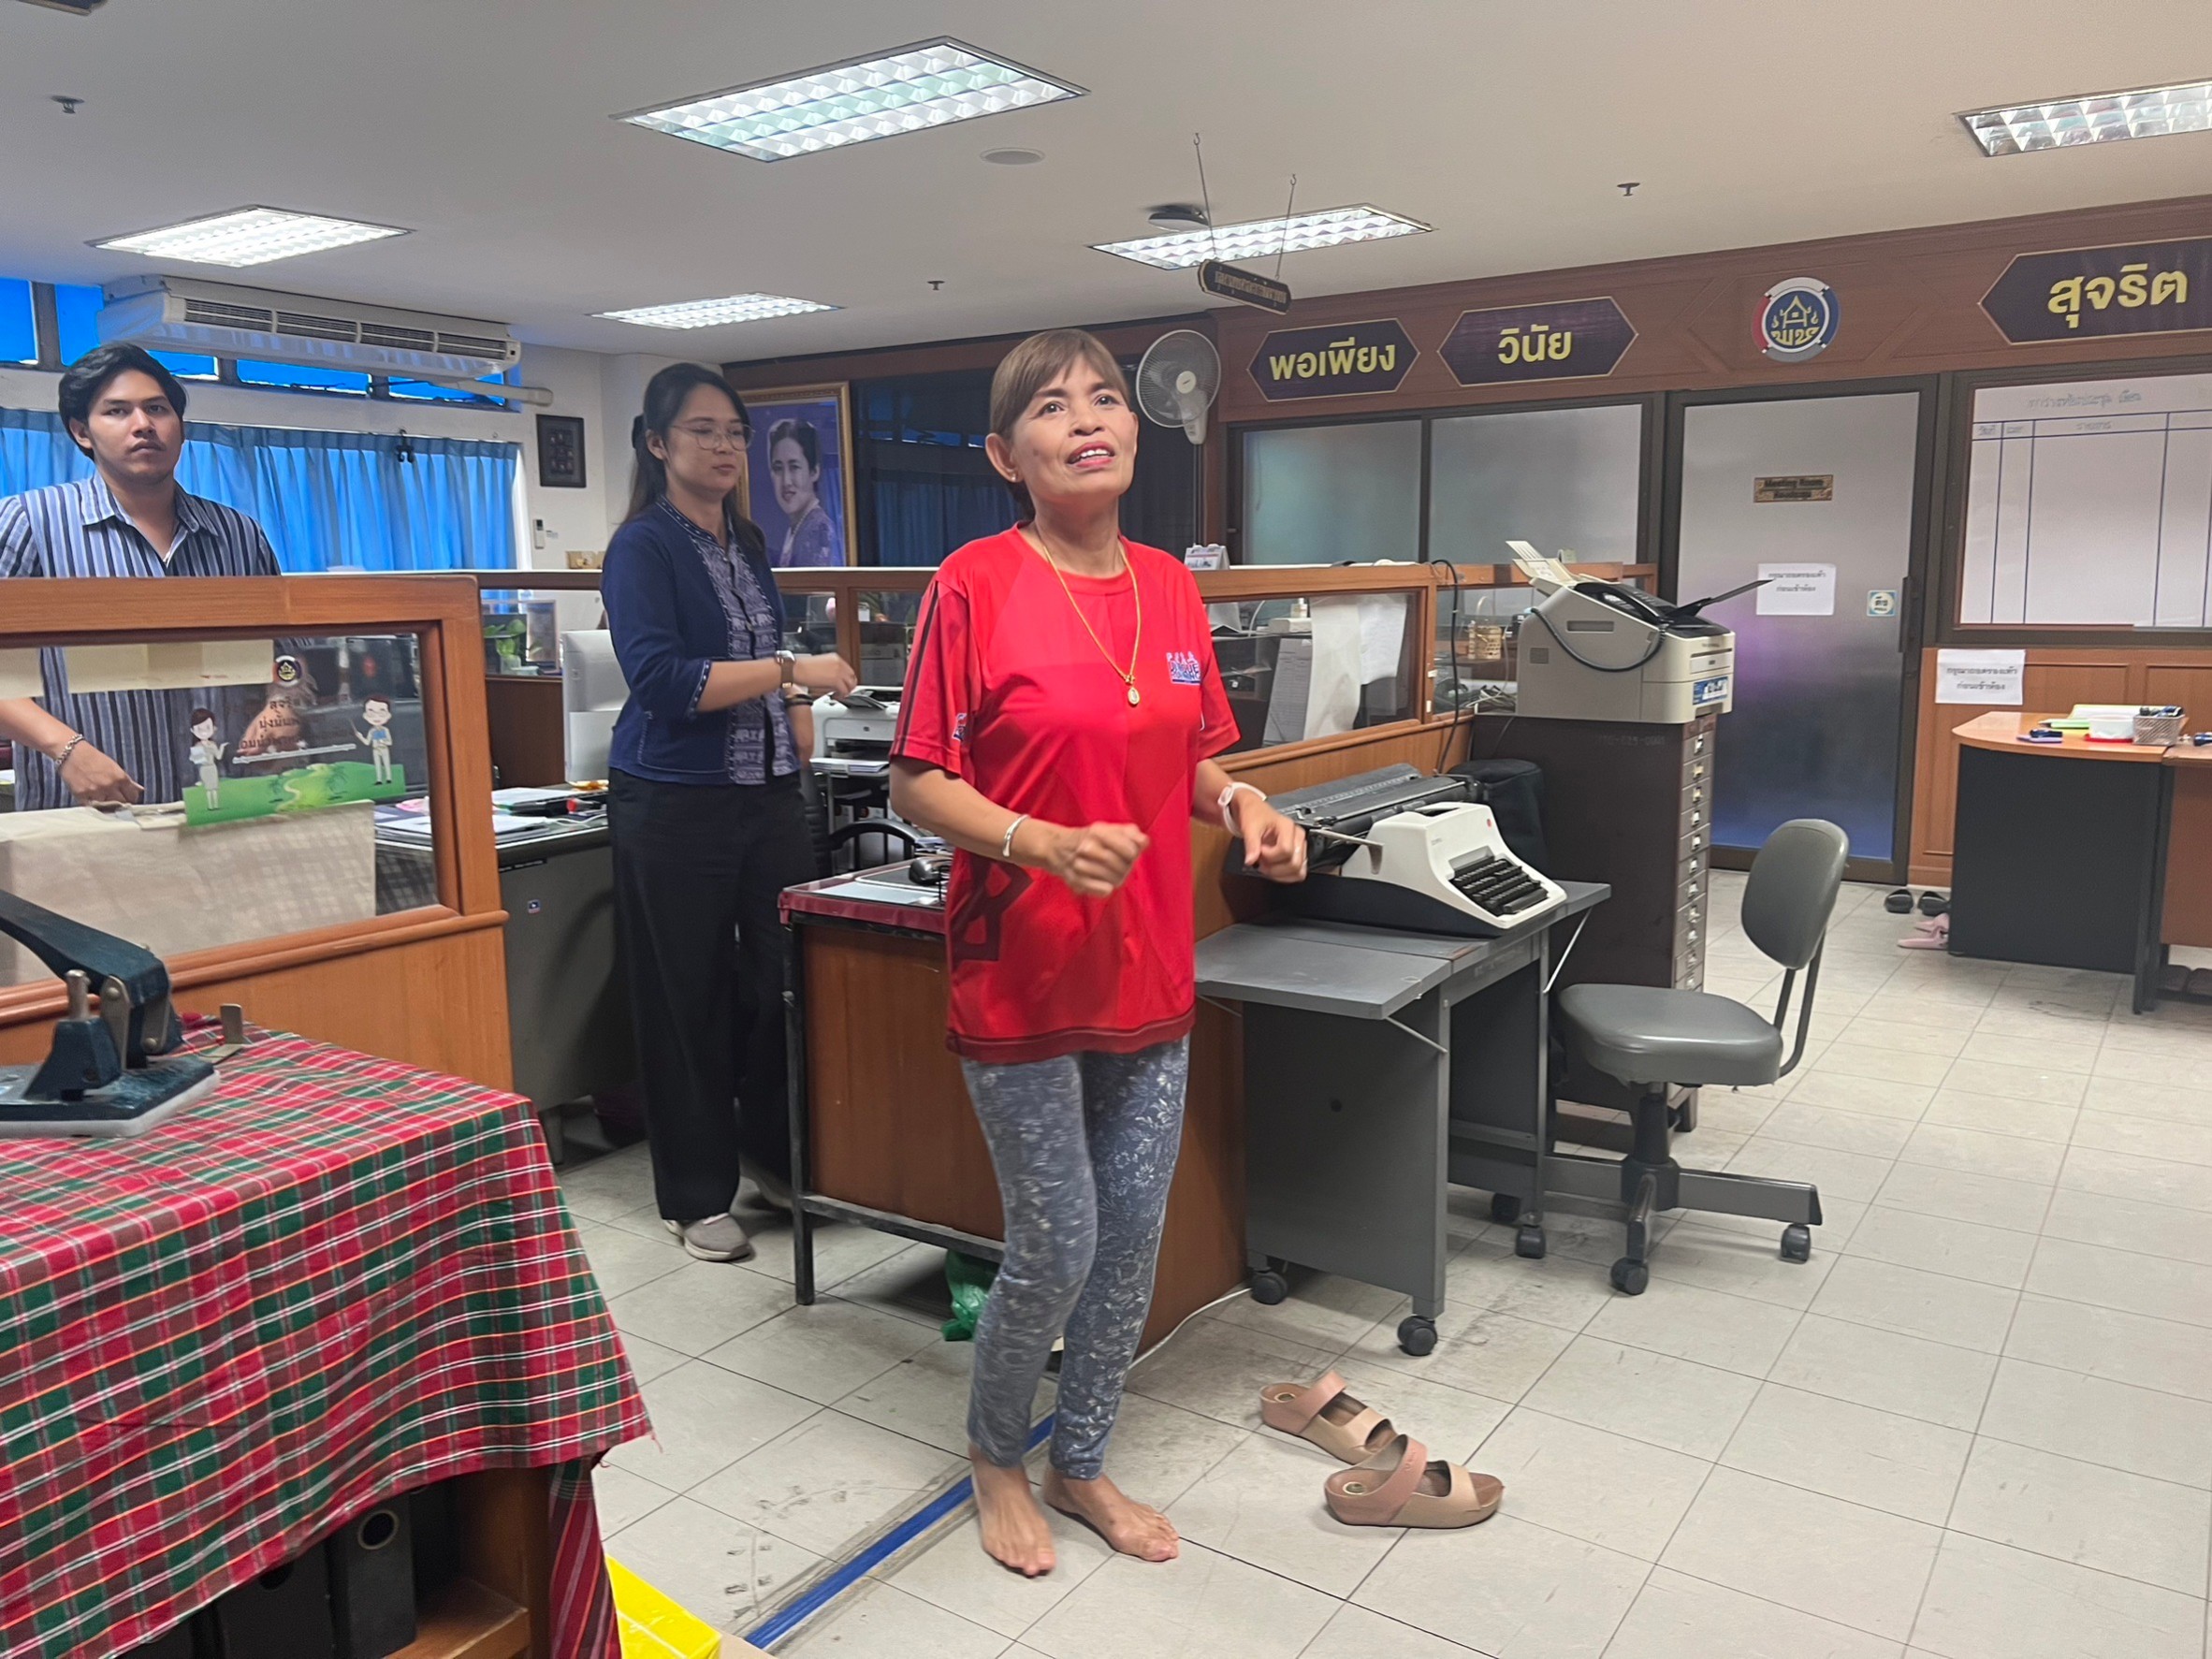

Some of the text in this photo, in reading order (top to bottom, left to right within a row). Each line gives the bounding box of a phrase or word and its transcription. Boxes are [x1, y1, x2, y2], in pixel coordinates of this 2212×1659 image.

[2048, 263, 2188, 328] สุจริต
[1270, 337, 1396, 381] พอเพียง
[1498, 325, 1572, 364] วินัย
